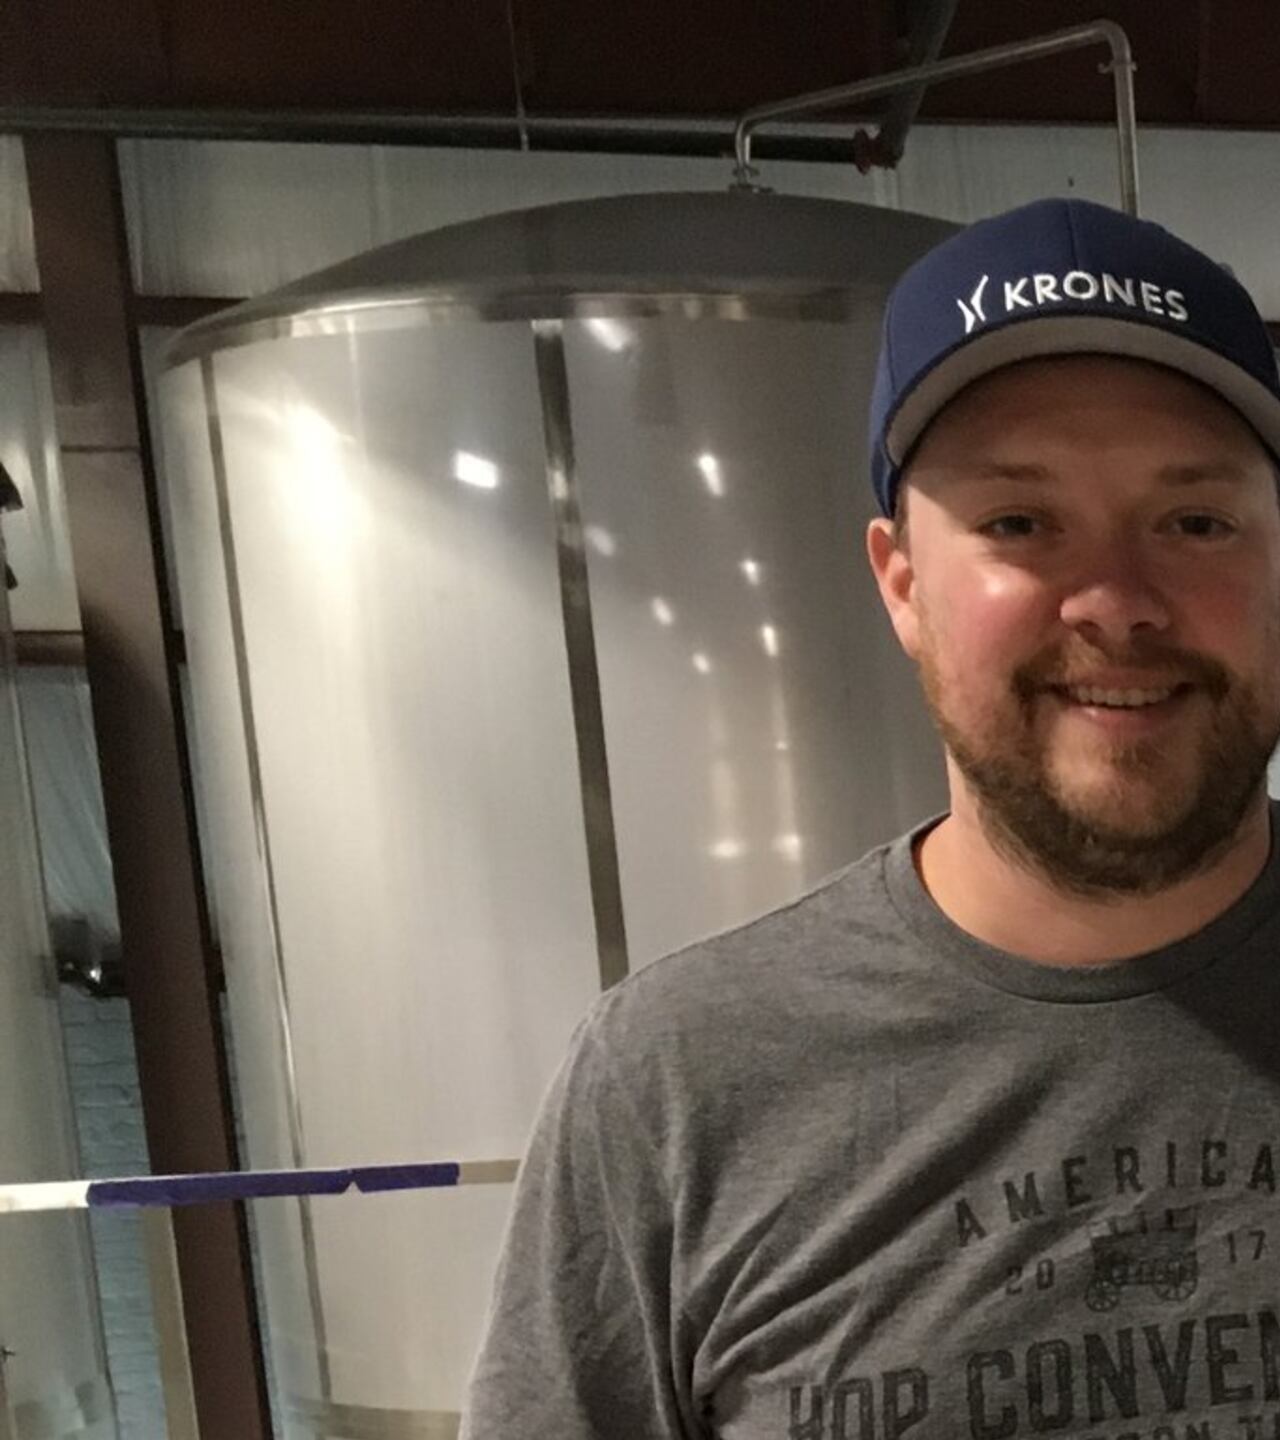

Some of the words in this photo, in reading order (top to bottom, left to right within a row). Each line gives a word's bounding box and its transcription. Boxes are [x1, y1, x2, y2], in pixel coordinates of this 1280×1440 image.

[1004, 270, 1188, 322] KRONES
[1005, 1258, 1055, 1295] 20
[1225, 1230, 1267, 1264] 17
